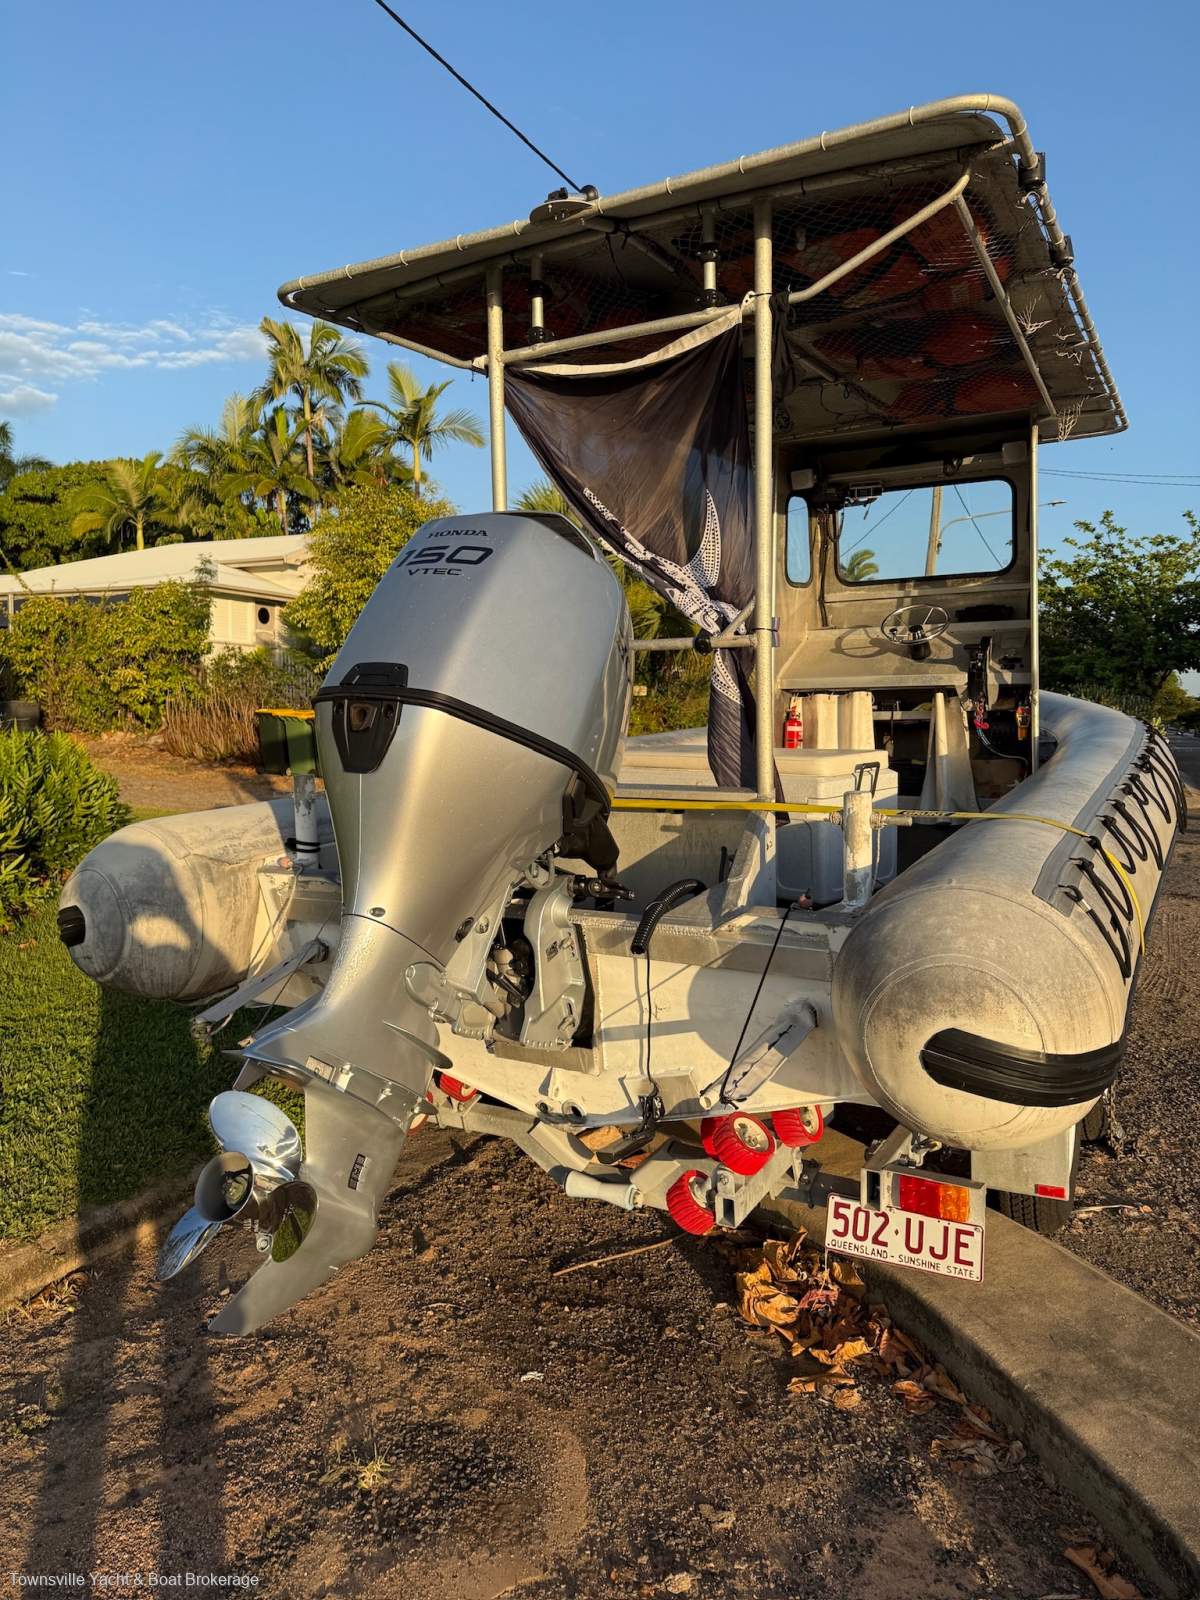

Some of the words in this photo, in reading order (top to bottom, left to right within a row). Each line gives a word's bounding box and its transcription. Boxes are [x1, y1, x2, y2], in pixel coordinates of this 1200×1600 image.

[427, 529, 489, 539] HONDA
[396, 545, 494, 568] 150
[408, 567, 462, 576] VTEC
[830, 1238, 889, 1260] QUEENSLAND
[898, 1254, 941, 1272] SUNSHINE
[946, 1264, 975, 1279] STATE
